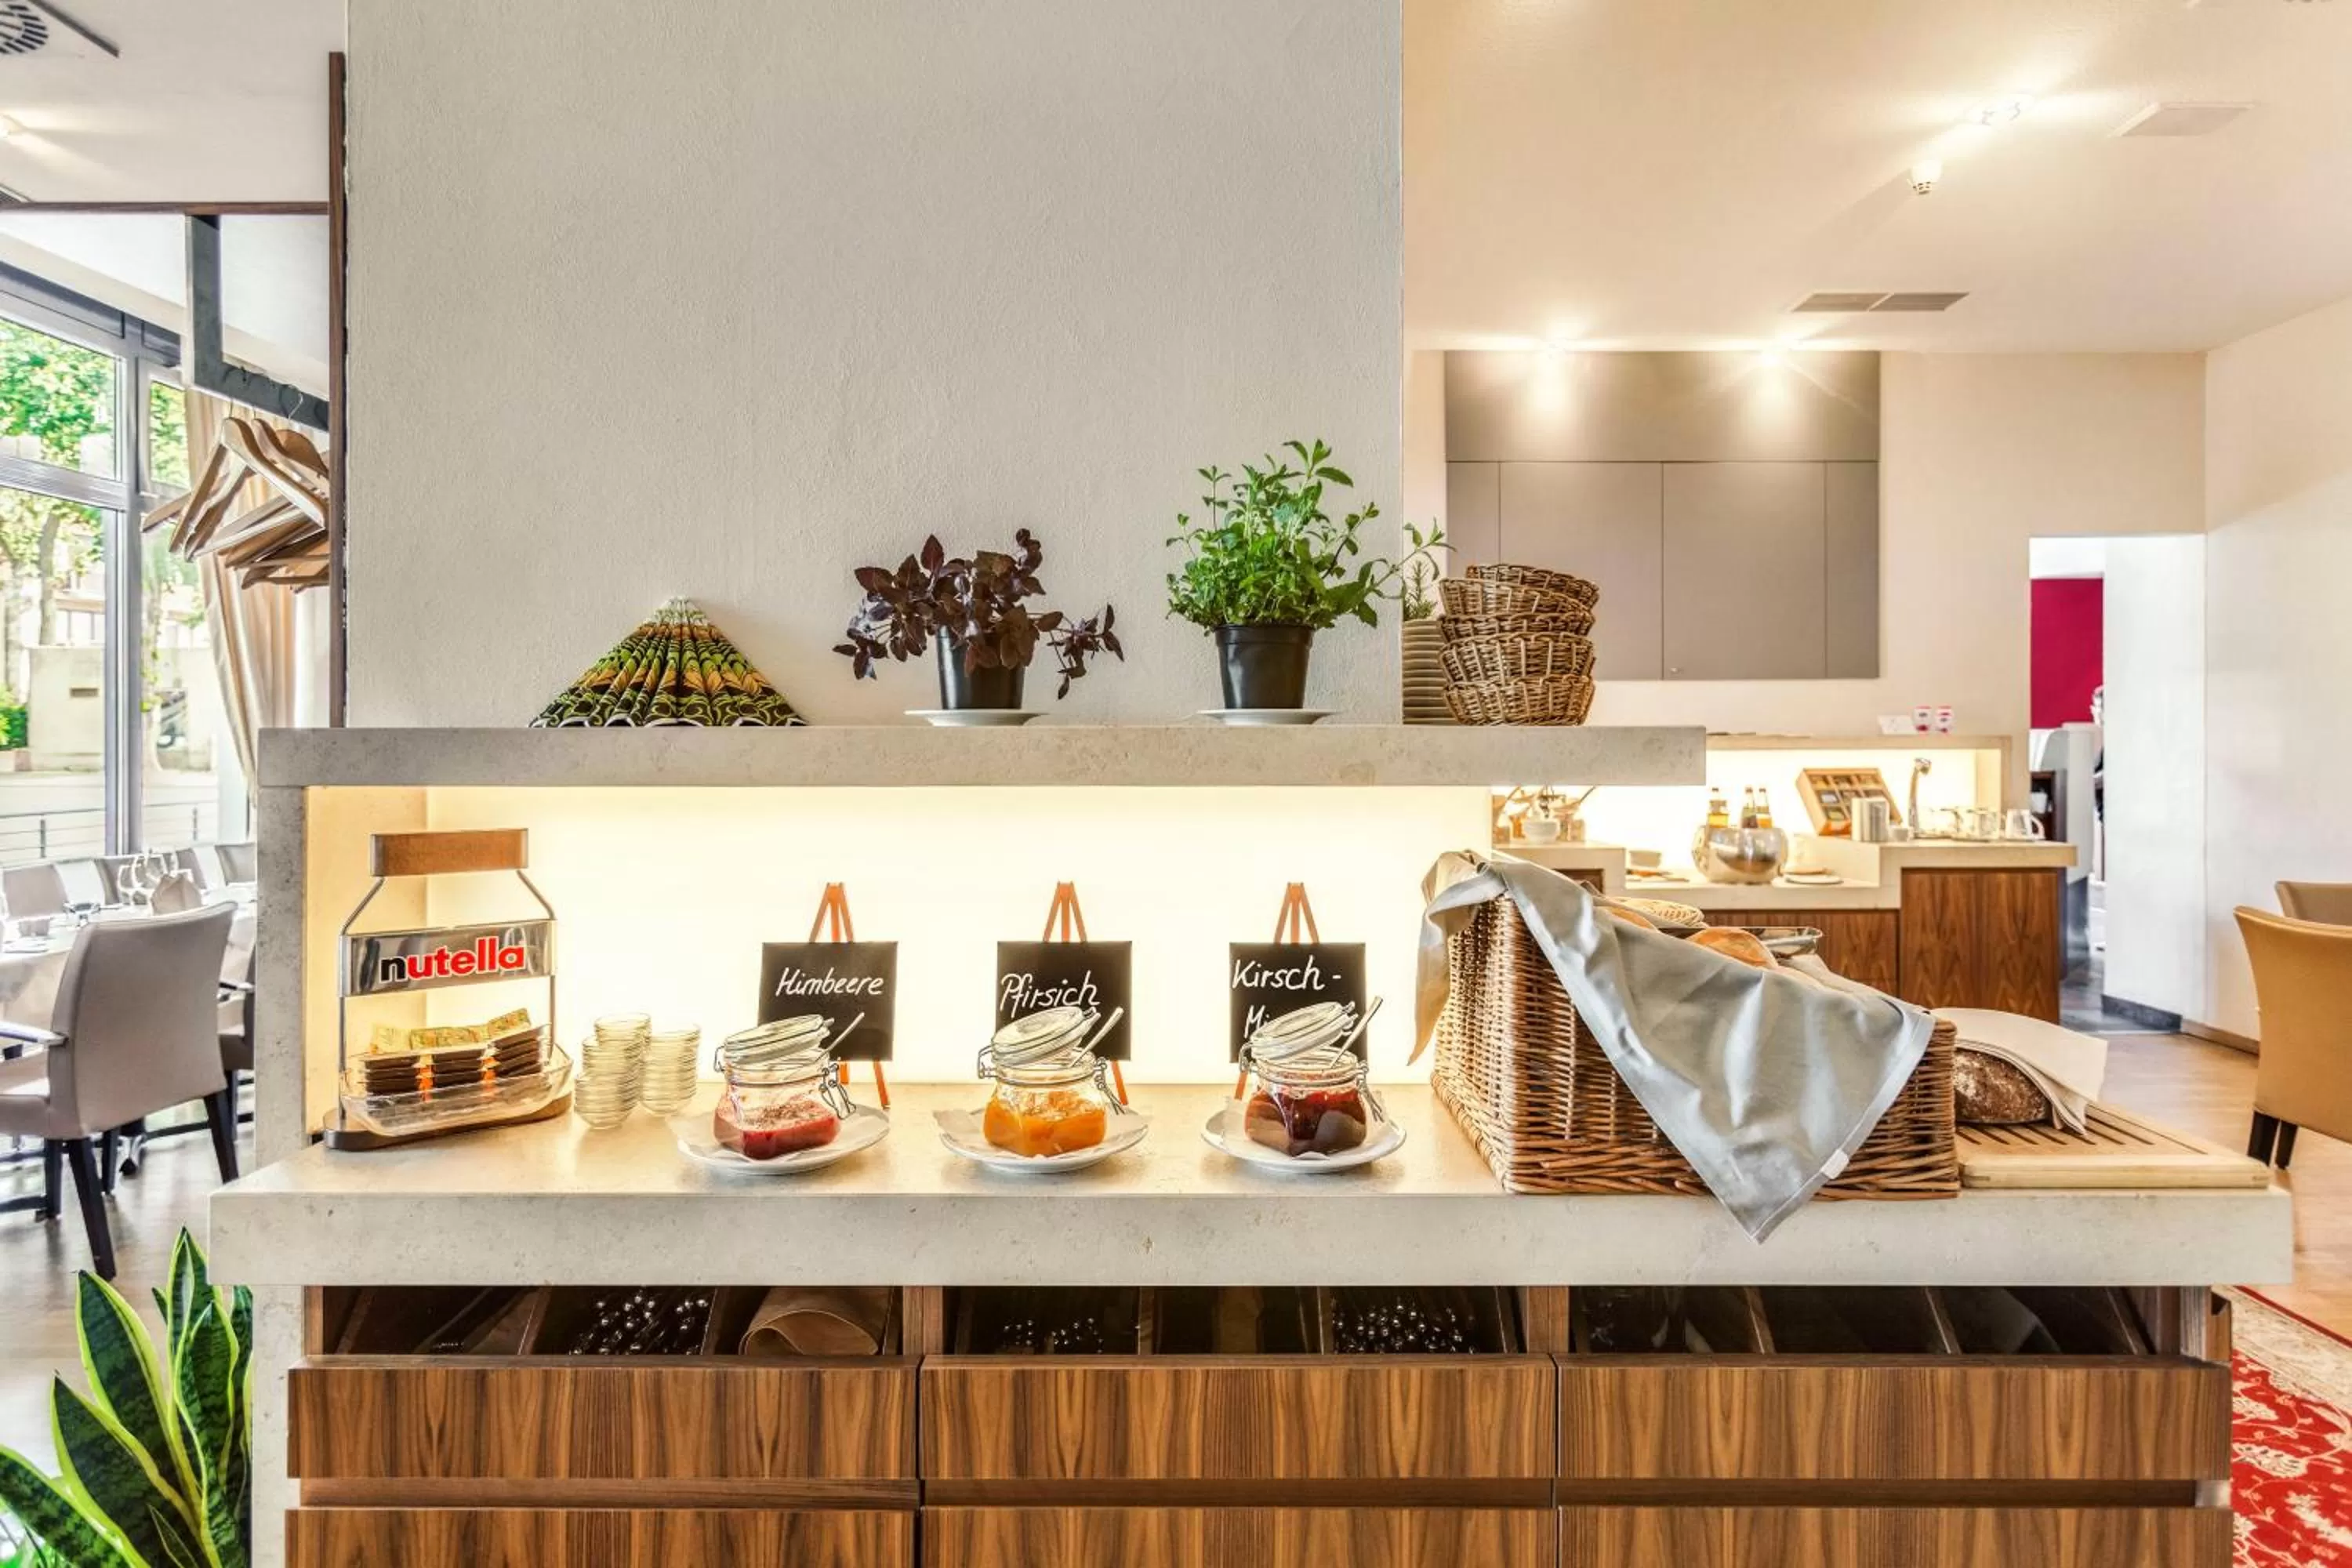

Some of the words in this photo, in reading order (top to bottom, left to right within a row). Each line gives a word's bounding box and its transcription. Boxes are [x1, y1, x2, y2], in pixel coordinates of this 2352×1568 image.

[379, 936, 526, 983] nutella
[775, 967, 884, 996] Himbeere
[1000, 969, 1101, 1018] Pfirsich
